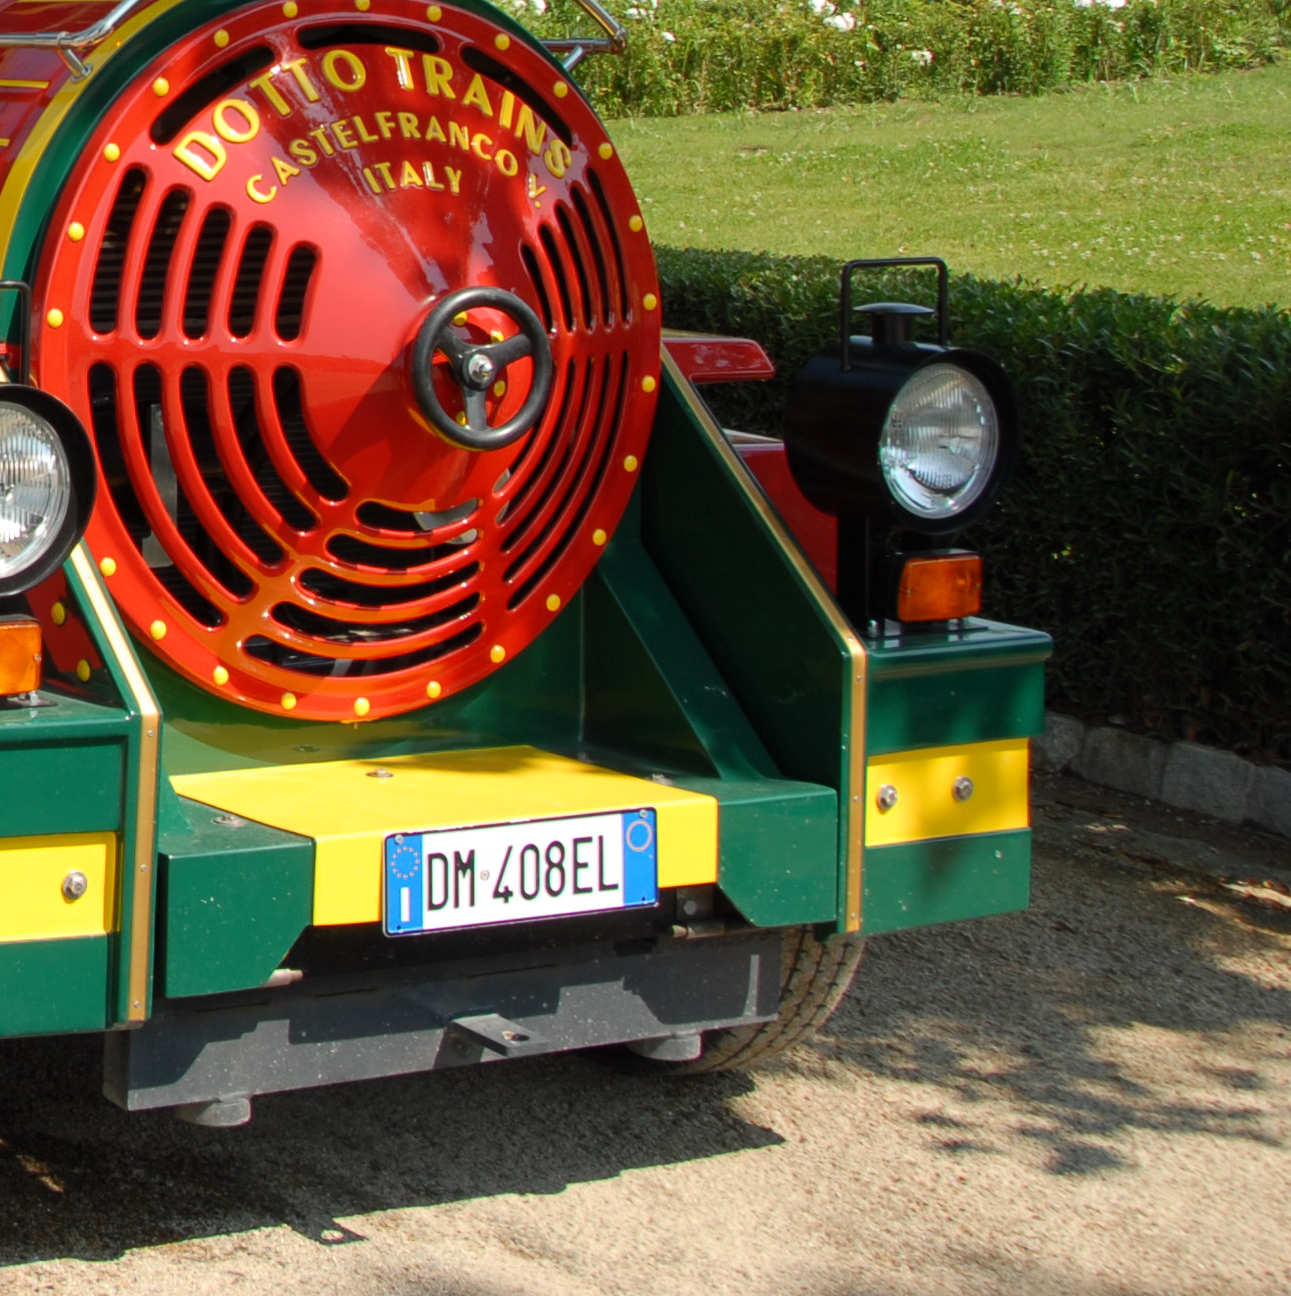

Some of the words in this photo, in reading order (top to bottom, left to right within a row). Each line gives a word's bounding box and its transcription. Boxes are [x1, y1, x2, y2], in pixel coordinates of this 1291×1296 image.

[173, 48, 366, 182] DOTTO
[384, 46, 572, 179] TRAINS
[245, 110, 519, 205] CASTELFRANCO
[362, 160, 463, 196] ITALY
[427, 849, 475, 912] DM
[492, 835, 619, 905] 408EL
